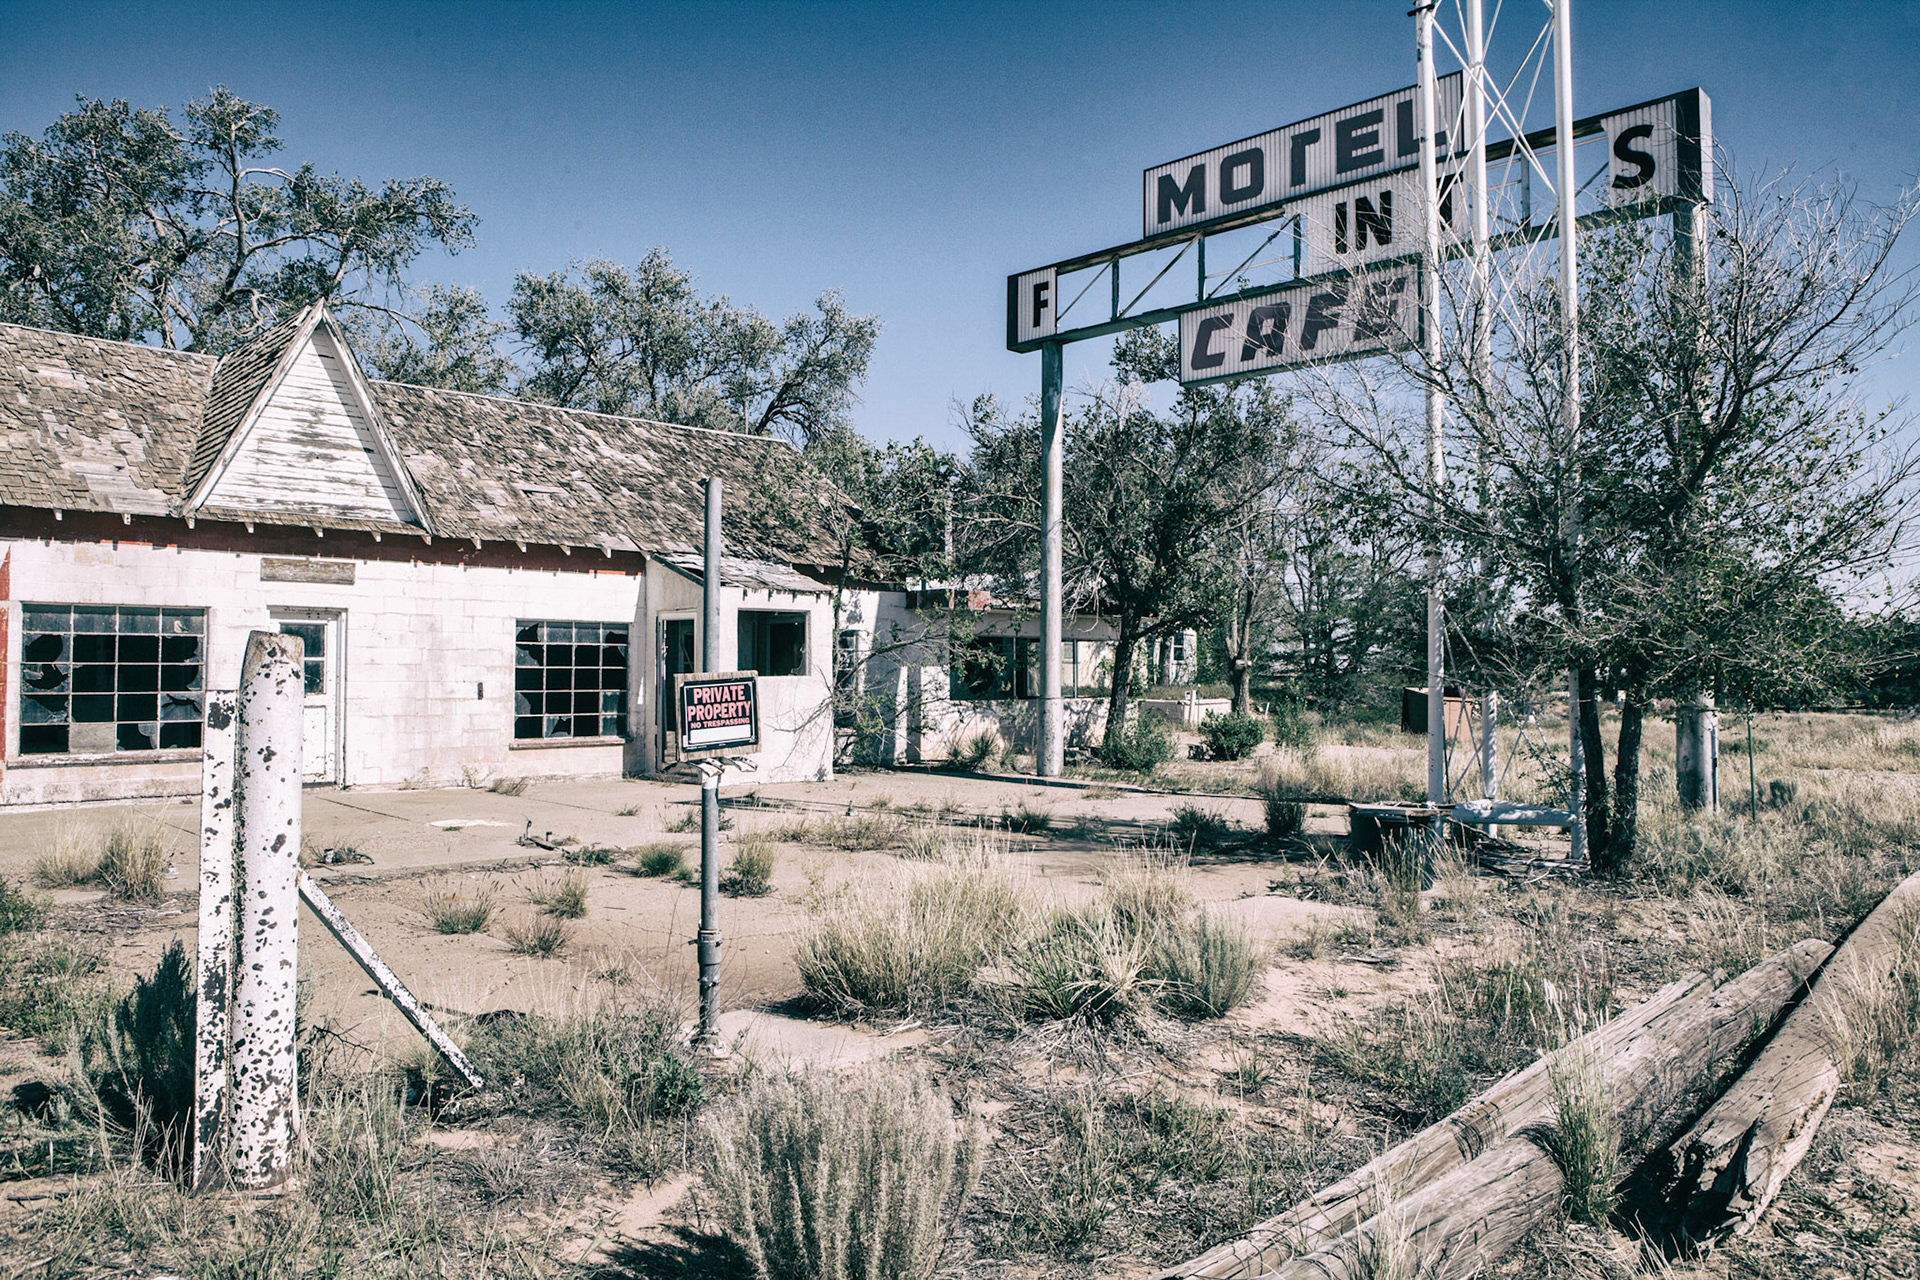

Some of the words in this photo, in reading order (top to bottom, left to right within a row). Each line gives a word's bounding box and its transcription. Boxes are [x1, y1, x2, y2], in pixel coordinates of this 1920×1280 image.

[1157, 98, 1447, 225] MOTEL
[1033, 280, 1049, 328] F
[1335, 189, 1392, 255] IN
[1611, 124, 1656, 189] S
[1190, 276, 1407, 371] CAFE
[687, 701, 751, 722] PROPERTY
[690, 721, 702, 729] NO
[703, 717, 750, 728] TRESPASSING
[693, 684, 746, 704] PRIVATE
